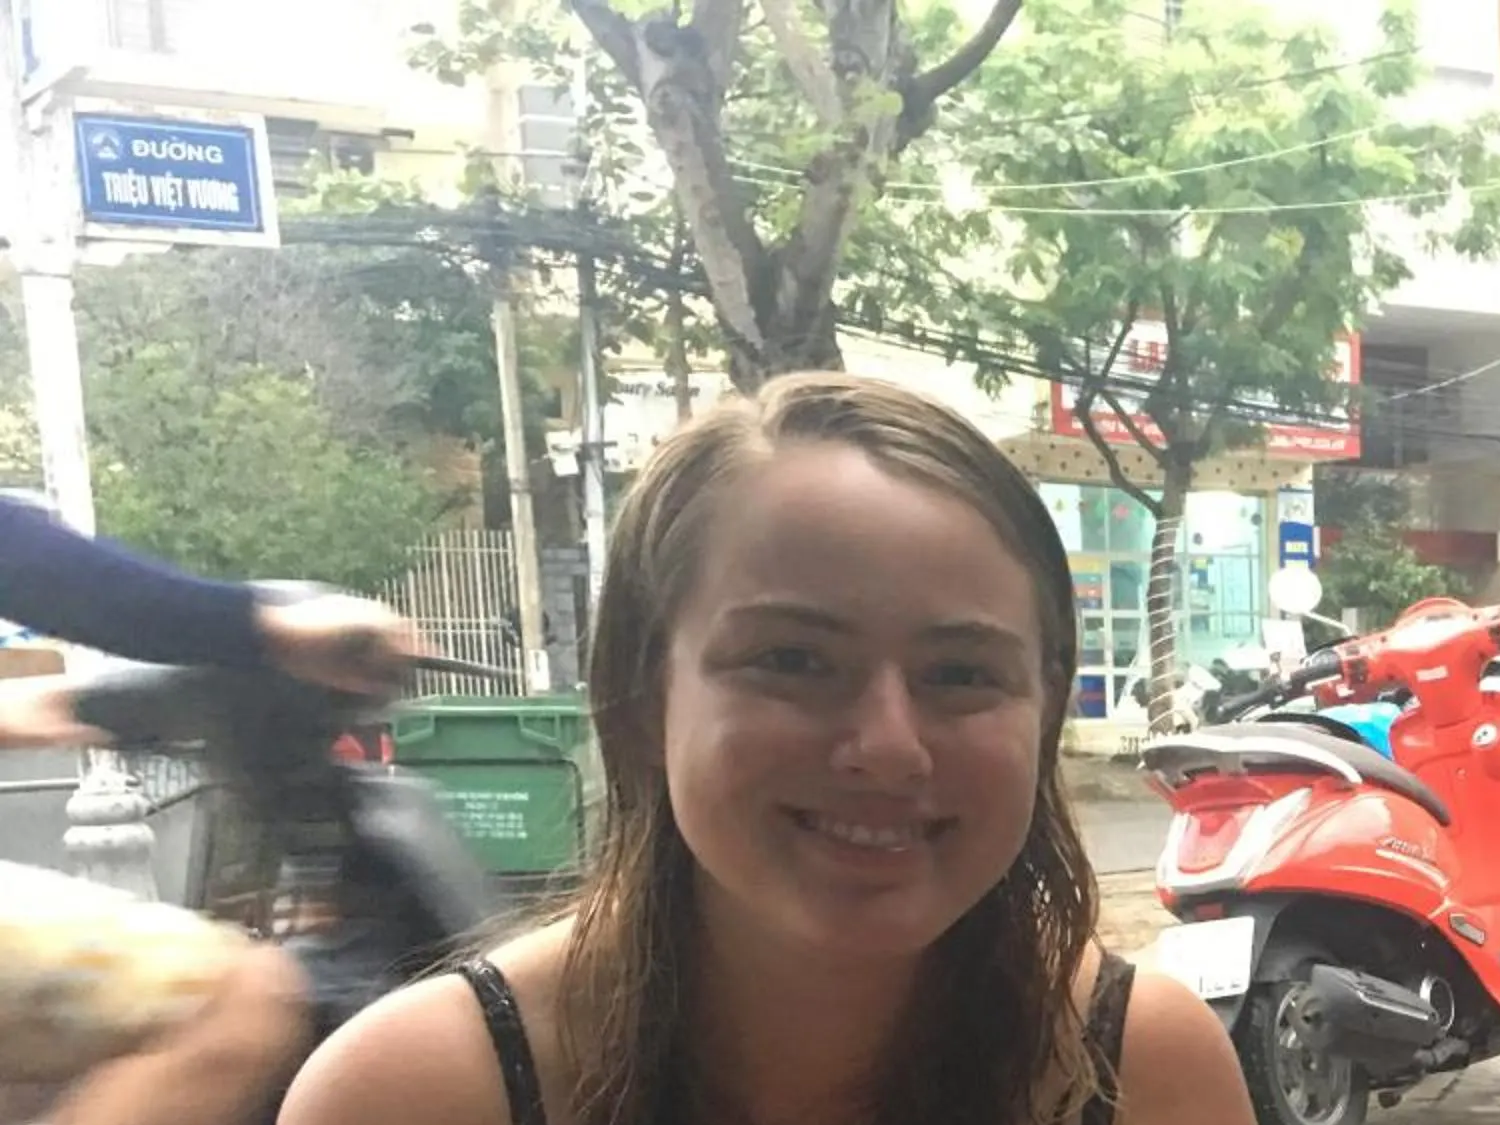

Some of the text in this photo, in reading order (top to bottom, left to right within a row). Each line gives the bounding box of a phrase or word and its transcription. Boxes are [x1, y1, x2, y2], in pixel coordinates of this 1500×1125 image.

[132, 136, 223, 163] ĐƯỜNG
[102, 168, 149, 208] TRIỆU
[150, 171, 185, 213] VIỆT
